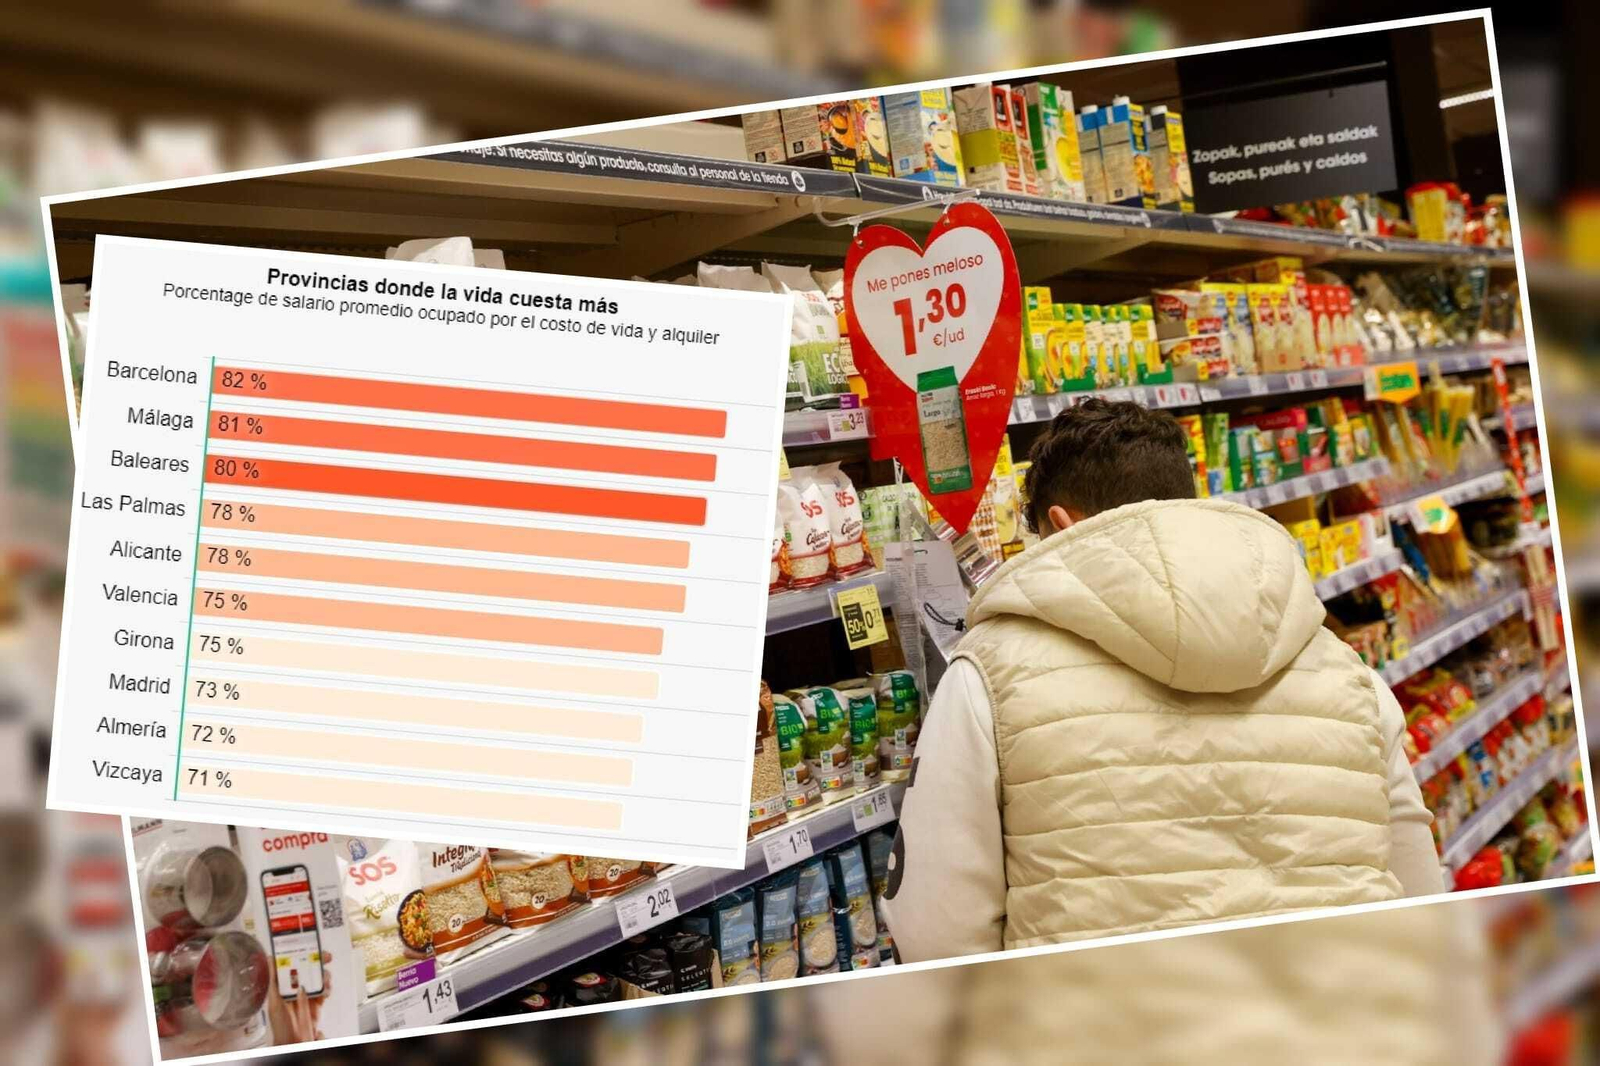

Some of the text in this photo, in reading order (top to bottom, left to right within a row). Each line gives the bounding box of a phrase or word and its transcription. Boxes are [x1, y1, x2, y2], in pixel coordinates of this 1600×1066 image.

[1192, 125, 1379, 164] Zopak, pureak eta saldak
[510, 147, 564, 163] necesitas
[567, 151, 598, 169] algún
[649, 162, 687, 177] consulta
[689, 165, 698, 177] al
[699, 168, 738, 181] personal
[739, 169, 751, 182] de
[752, 170, 762, 183] la
[762, 173, 789, 185] tienda
[1208, 152, 1368, 185] Sopas, purés y caldos
[867, 254, 984, 293] Me pones meloso
[893, 282, 967, 356] 1,30
[933, 328, 965, 347] €/ud
[780, 724, 798, 736] BIO
[262, 832, 329, 853] compra
[788, 828, 808, 855] 1,70
[348, 856, 397, 886] SOS
[609, 868, 619, 877] 20
[534, 895, 545, 904] 20
[647, 888, 671, 918] 2,02
[451, 916, 462, 928] 20
[422, 979, 453, 1014] 1,43
